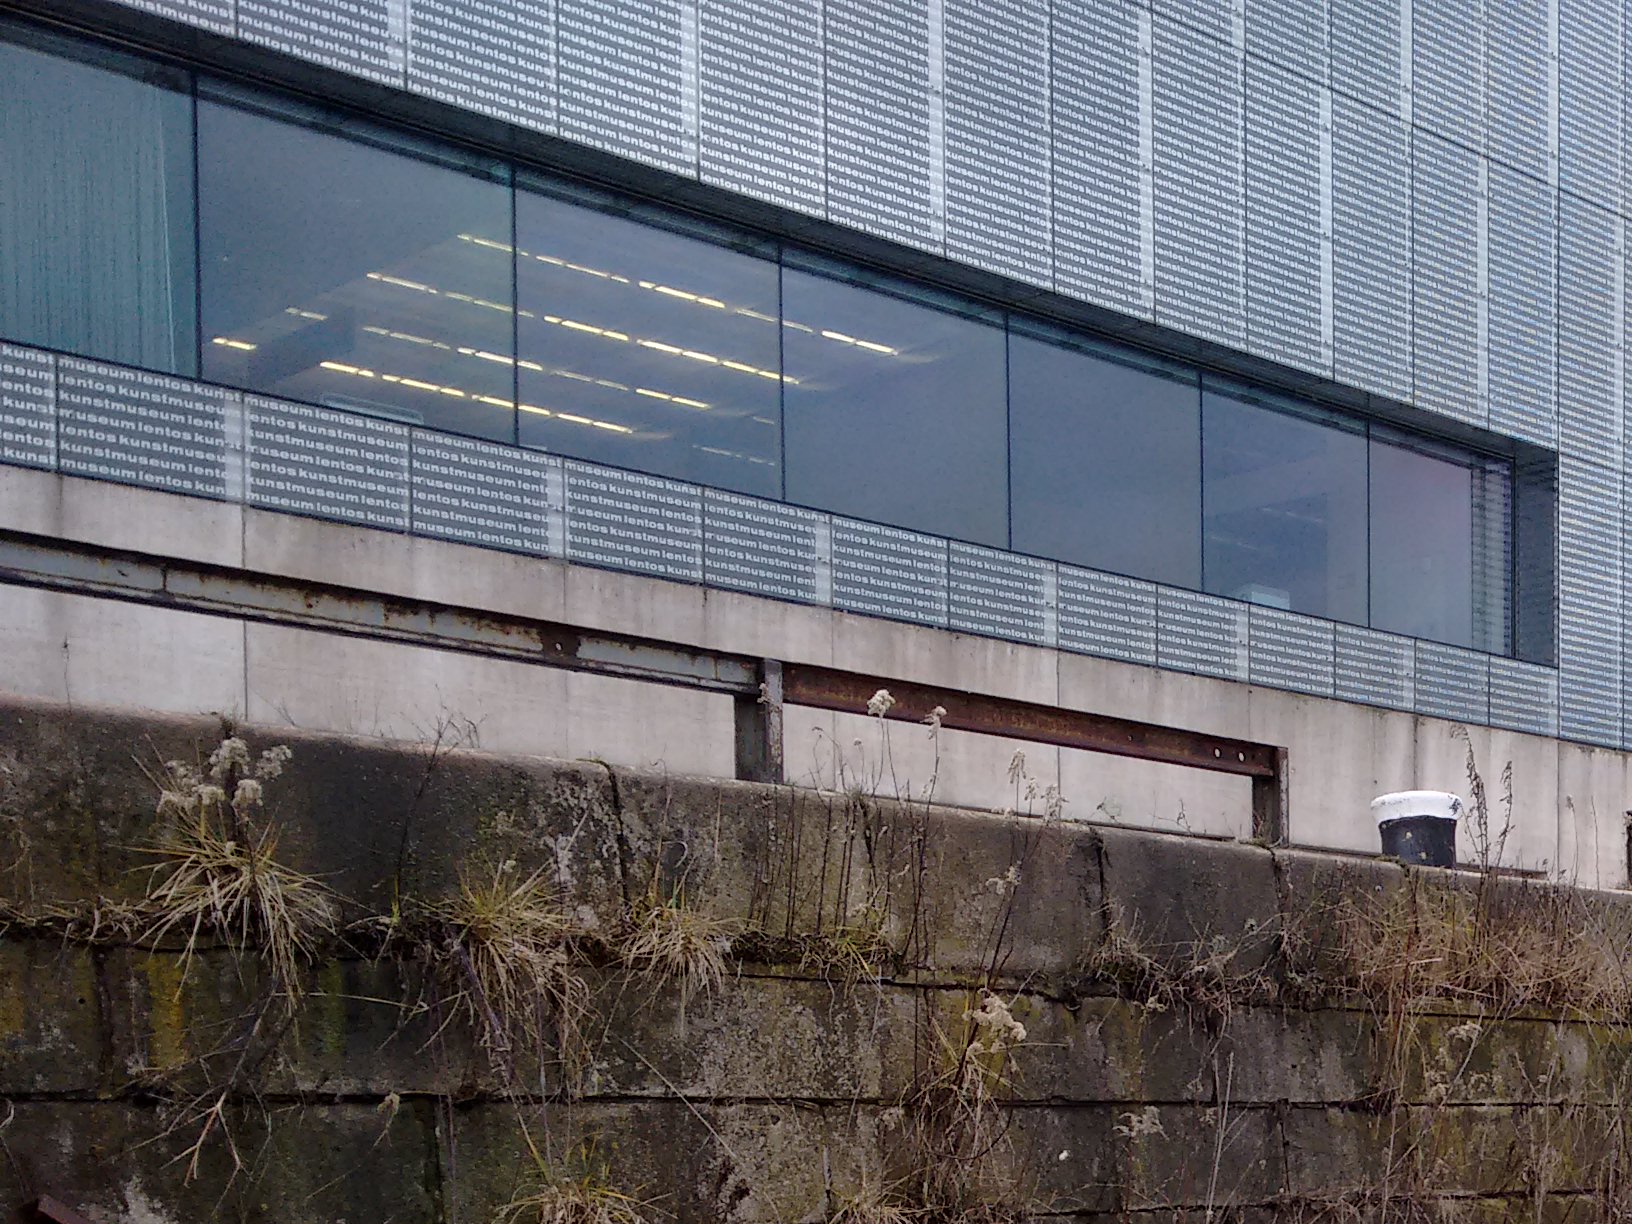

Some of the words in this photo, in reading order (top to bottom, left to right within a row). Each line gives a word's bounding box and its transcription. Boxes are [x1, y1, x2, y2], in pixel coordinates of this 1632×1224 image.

[59, 374, 115, 394] lentos
[137, 372, 191, 392] lentos
[59, 391, 184, 423] kunstmuseum
[316, 408, 364, 427] lentos
[60, 424, 116, 443] lentos
[138, 422, 192, 441] lentos
[299, 421, 408, 451] kunstmuseum
[61, 441, 185, 472] kunstmuseum
[361, 448, 408, 466] lentos
[413, 443, 459, 461] lentos
[477, 441, 520, 459] lentos
[317, 455, 364, 473] lentos
[413, 458, 515, 487] kunstmuseum
[139, 471, 192, 489] lentos
[300, 467, 409, 496] kunstmuseum
[362, 494, 409, 511] lentos
[413, 489, 459, 506] lentos
[477, 486, 521, 503] lentos
[317, 501, 365, 519] lentos
[414, 504, 516, 531] kunstmuseum
[478, 530, 522, 546] lentos
